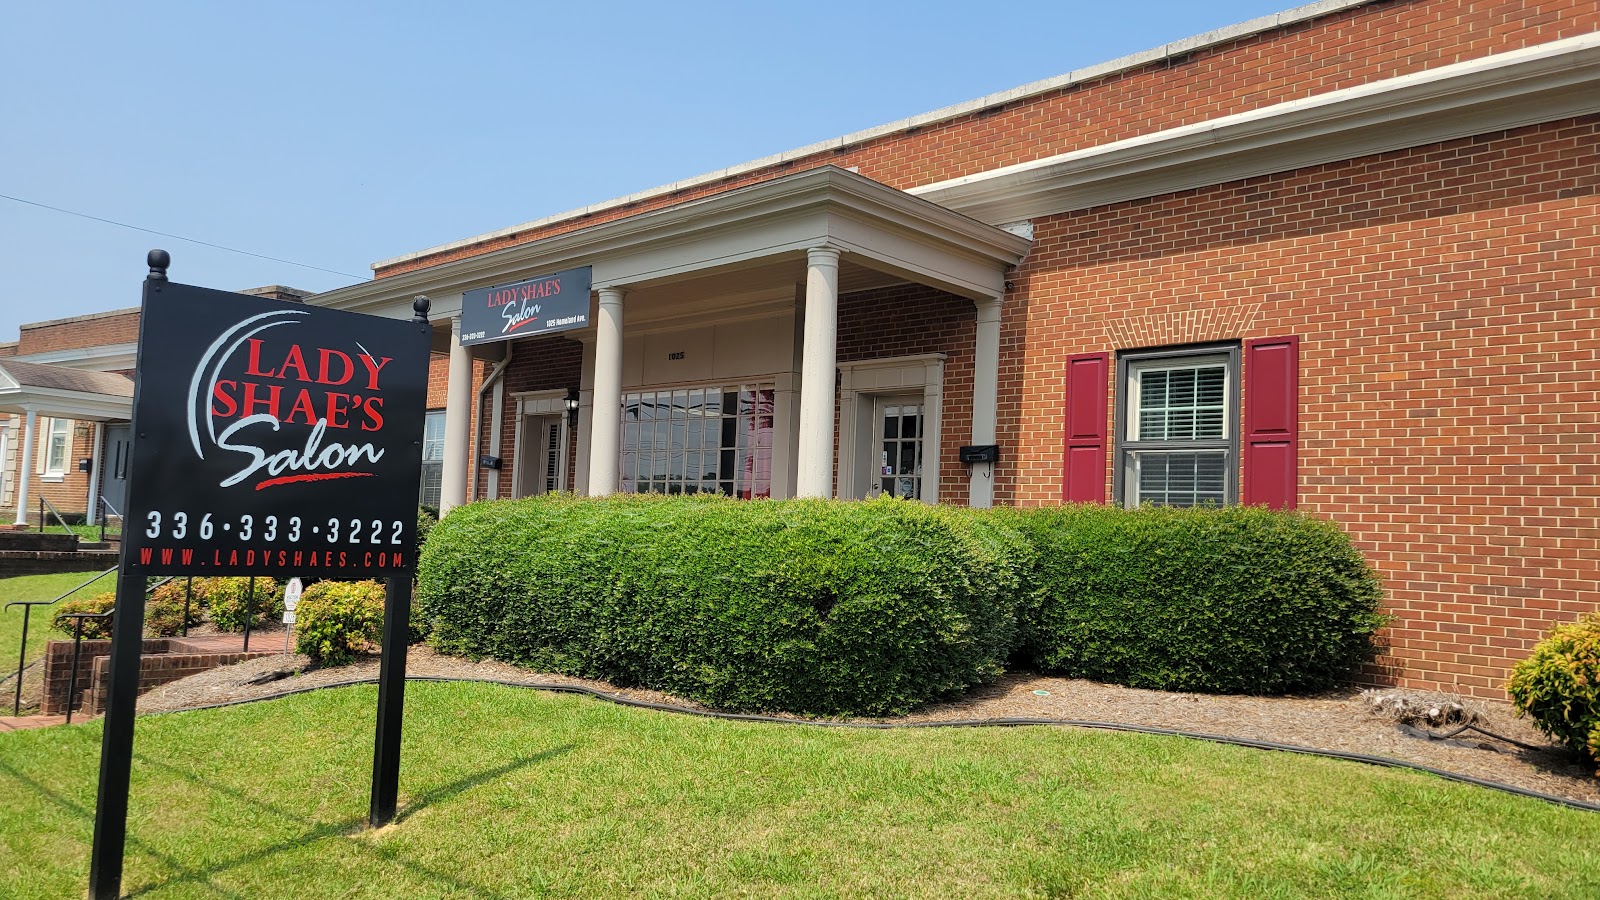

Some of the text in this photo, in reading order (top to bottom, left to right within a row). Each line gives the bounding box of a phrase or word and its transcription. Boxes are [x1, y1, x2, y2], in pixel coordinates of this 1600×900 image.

[488, 278, 561, 308] LADY SHAE'S
[502, 297, 541, 333] Salon
[245, 338, 393, 391] LADY
[668, 351, 685, 361] 1025
[212, 380, 384, 431] SHAE'S
[218, 413, 385, 488] Salon
[140, 548, 402, 569] WWW.LADYSHAES.COM
